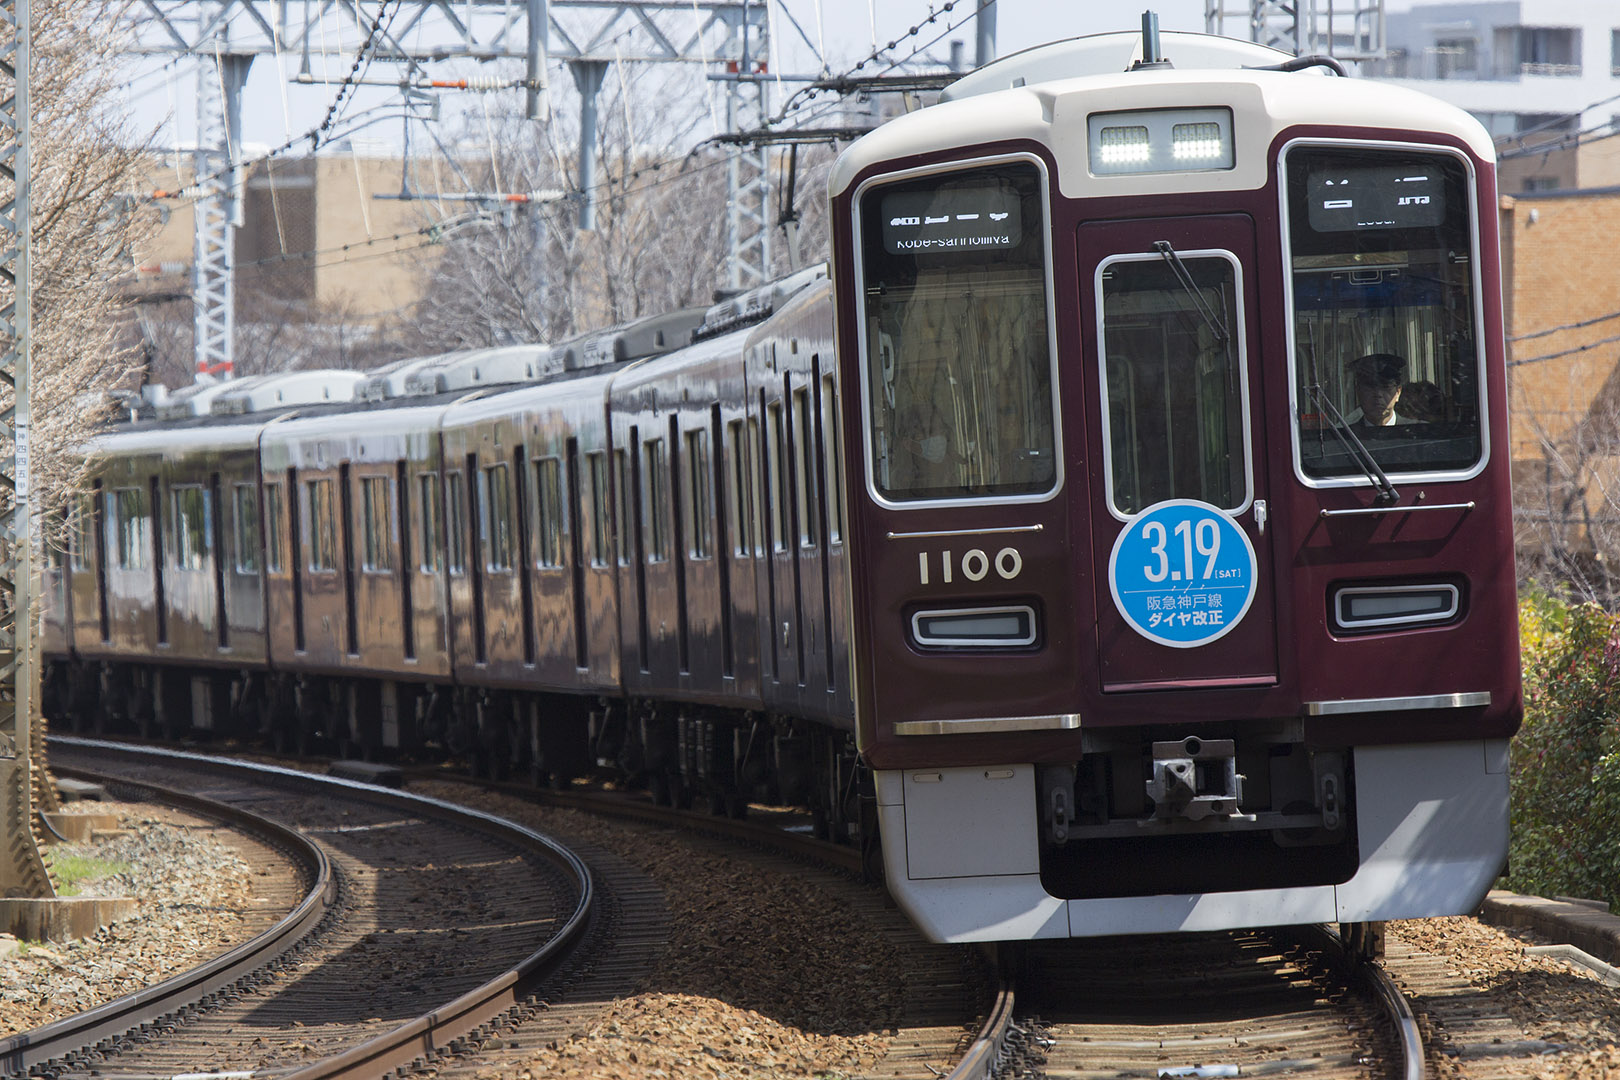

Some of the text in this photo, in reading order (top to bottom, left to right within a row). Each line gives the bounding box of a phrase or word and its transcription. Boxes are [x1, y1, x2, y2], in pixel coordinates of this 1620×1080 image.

[1142, 518, 1221, 583] 3.19
[919, 547, 1023, 585] 1100
[1146, 593, 1223, 611] 阪急神戸線
[1148, 610, 1224, 628] ダイヤ改正
